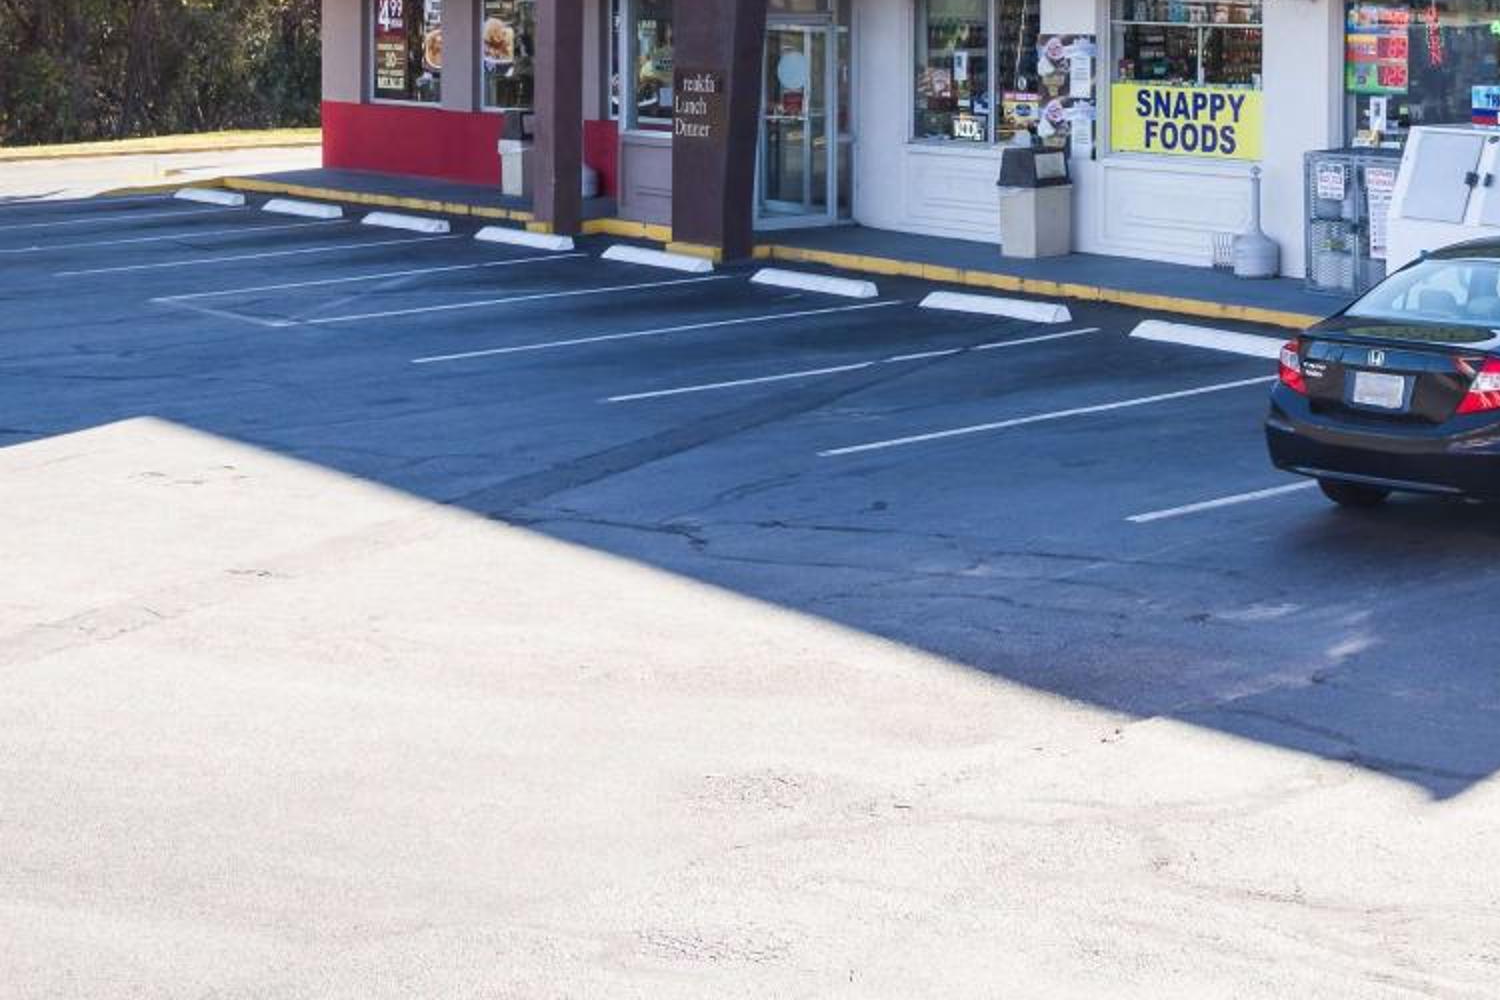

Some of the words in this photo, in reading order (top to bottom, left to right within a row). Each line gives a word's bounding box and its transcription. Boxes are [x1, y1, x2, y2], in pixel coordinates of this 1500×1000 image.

[675, 95, 706, 115] Lunch
[1136, 89, 1245, 122] SNAPPY
[675, 117, 711, 137] Dinner
[1145, 119, 1236, 154] FOODS
